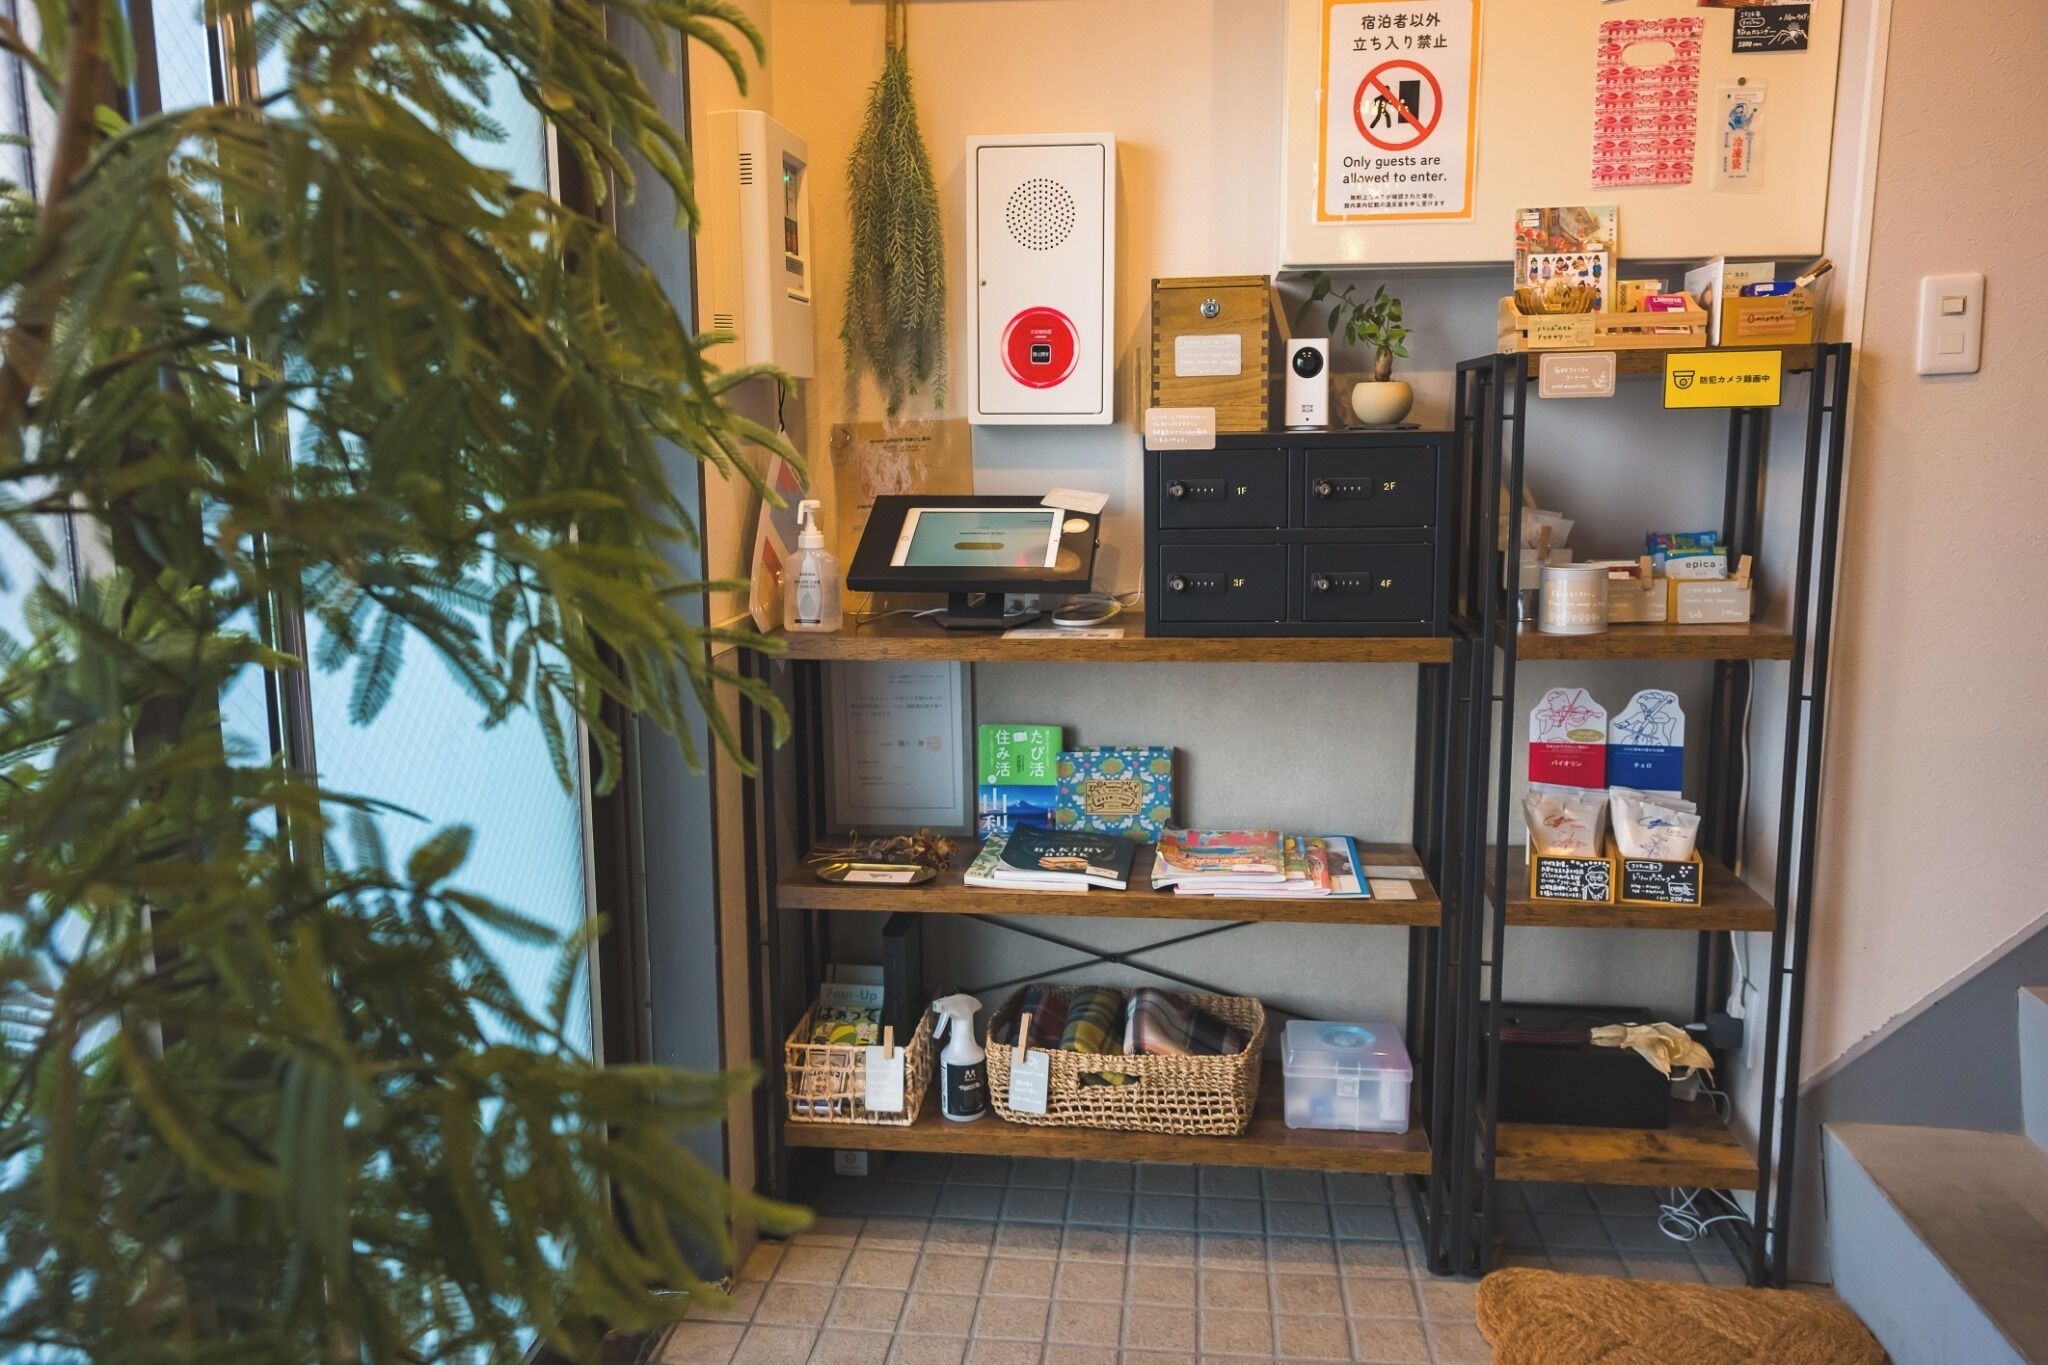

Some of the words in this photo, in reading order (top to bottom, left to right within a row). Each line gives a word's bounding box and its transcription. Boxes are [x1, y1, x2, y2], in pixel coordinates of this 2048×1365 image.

[1361, 12, 1441, 30] 宿泊者以外
[1353, 33, 1448, 51] 立ち入り禁止
[1343, 156, 1371, 170] Only
[1375, 156, 1416, 170] guests
[1420, 157, 1441, 166] are
[1343, 172, 1390, 184] allowed
[1394, 172, 1407, 183] to
[1410, 172, 1447, 182] enter.
[1700, 374, 1771, 384] 防犯カメラ録画中
[1236, 486, 1247, 495] 1F
[1383, 482, 1396, 491] 2F
[1685, 561, 1716, 570] epica
[1233, 579, 1245, 587] 3F
[1380, 579, 1392, 587] 4F
[995, 729, 1011, 777] 住み活
[1030, 729, 1046, 777] たび活
[1551, 759, 1583, 767] バイオリン
